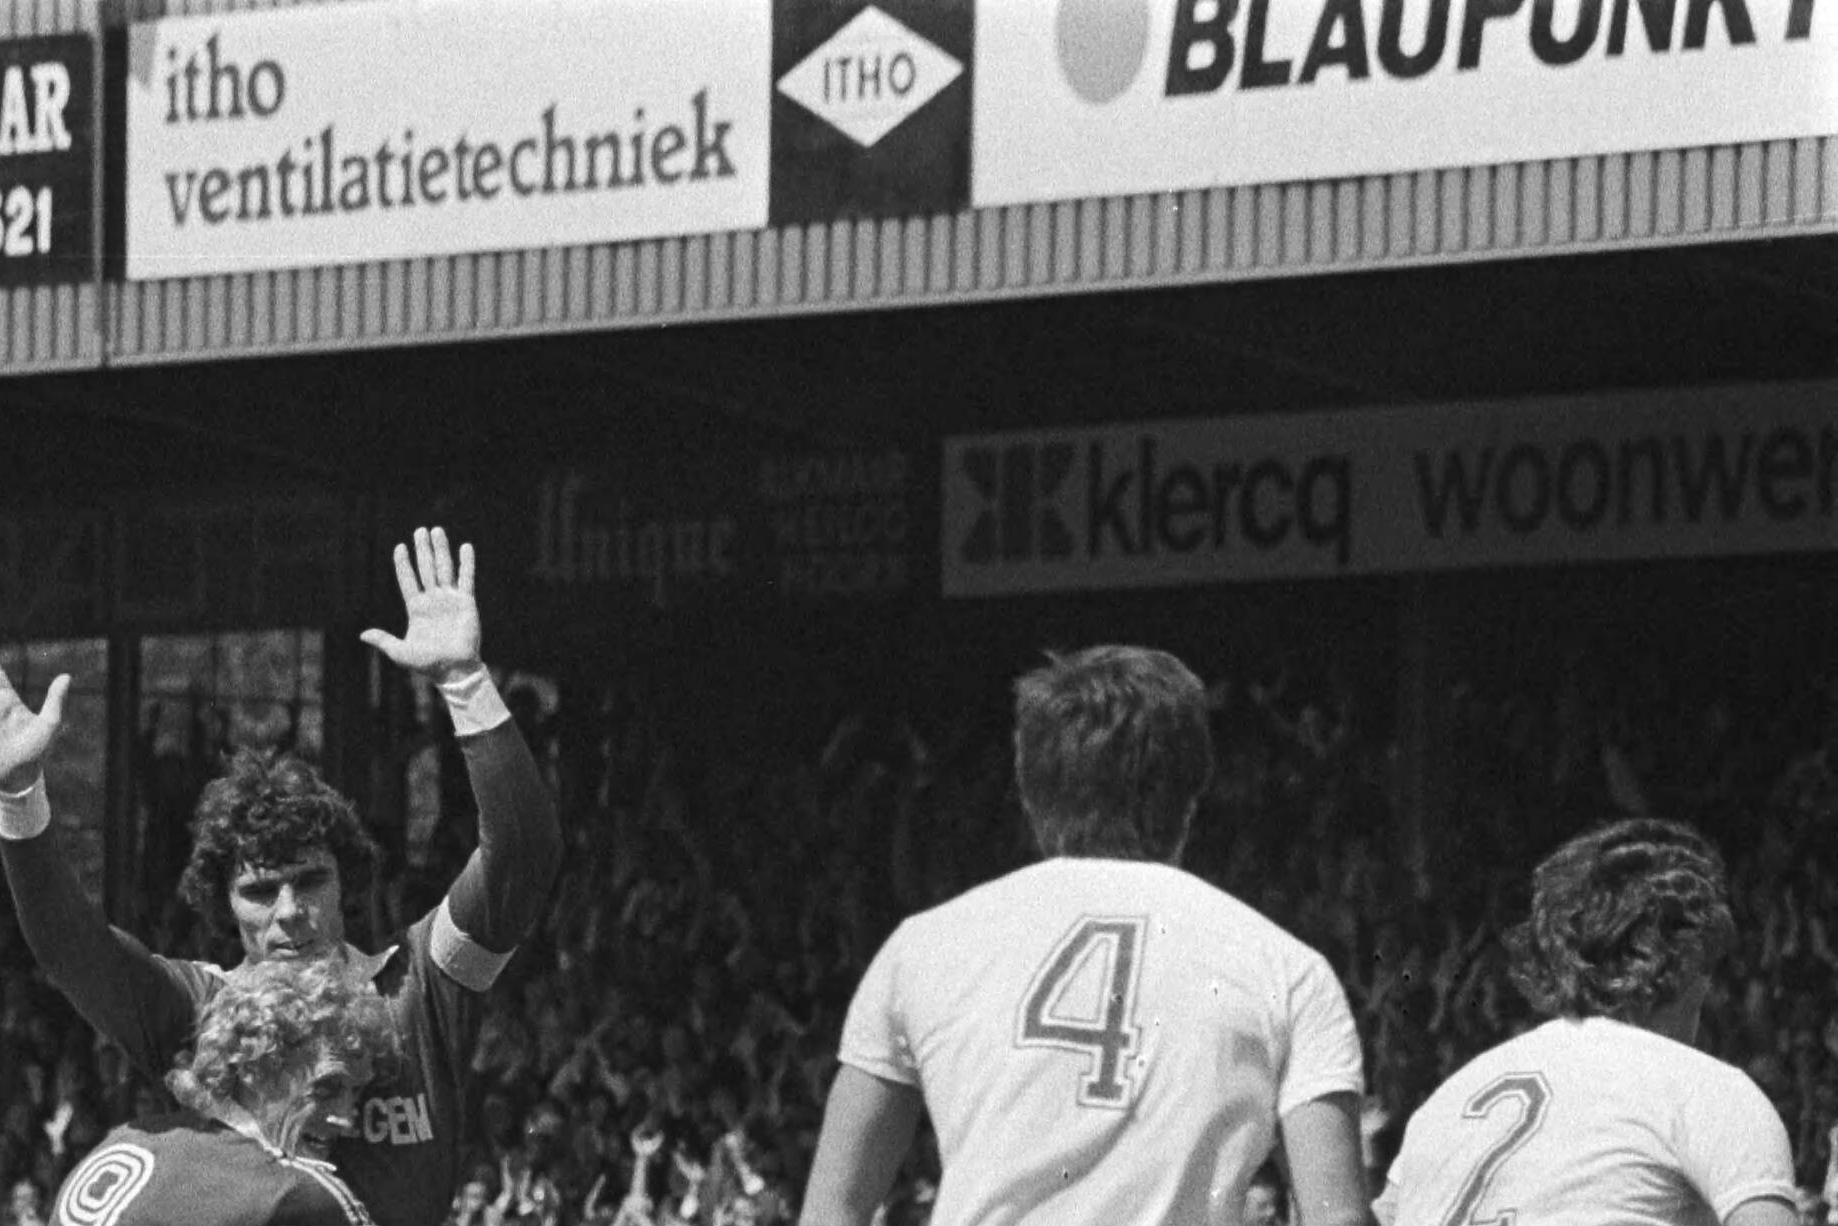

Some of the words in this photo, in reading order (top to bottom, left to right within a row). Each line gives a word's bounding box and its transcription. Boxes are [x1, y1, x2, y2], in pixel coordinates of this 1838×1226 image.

[163, 32, 286, 124] itho
[822, 52, 918, 103] ITHO
[163, 86, 739, 229] ventilatietechniek
[1087, 434, 1352, 567] klercq
[1014, 914, 1150, 1110] 4
